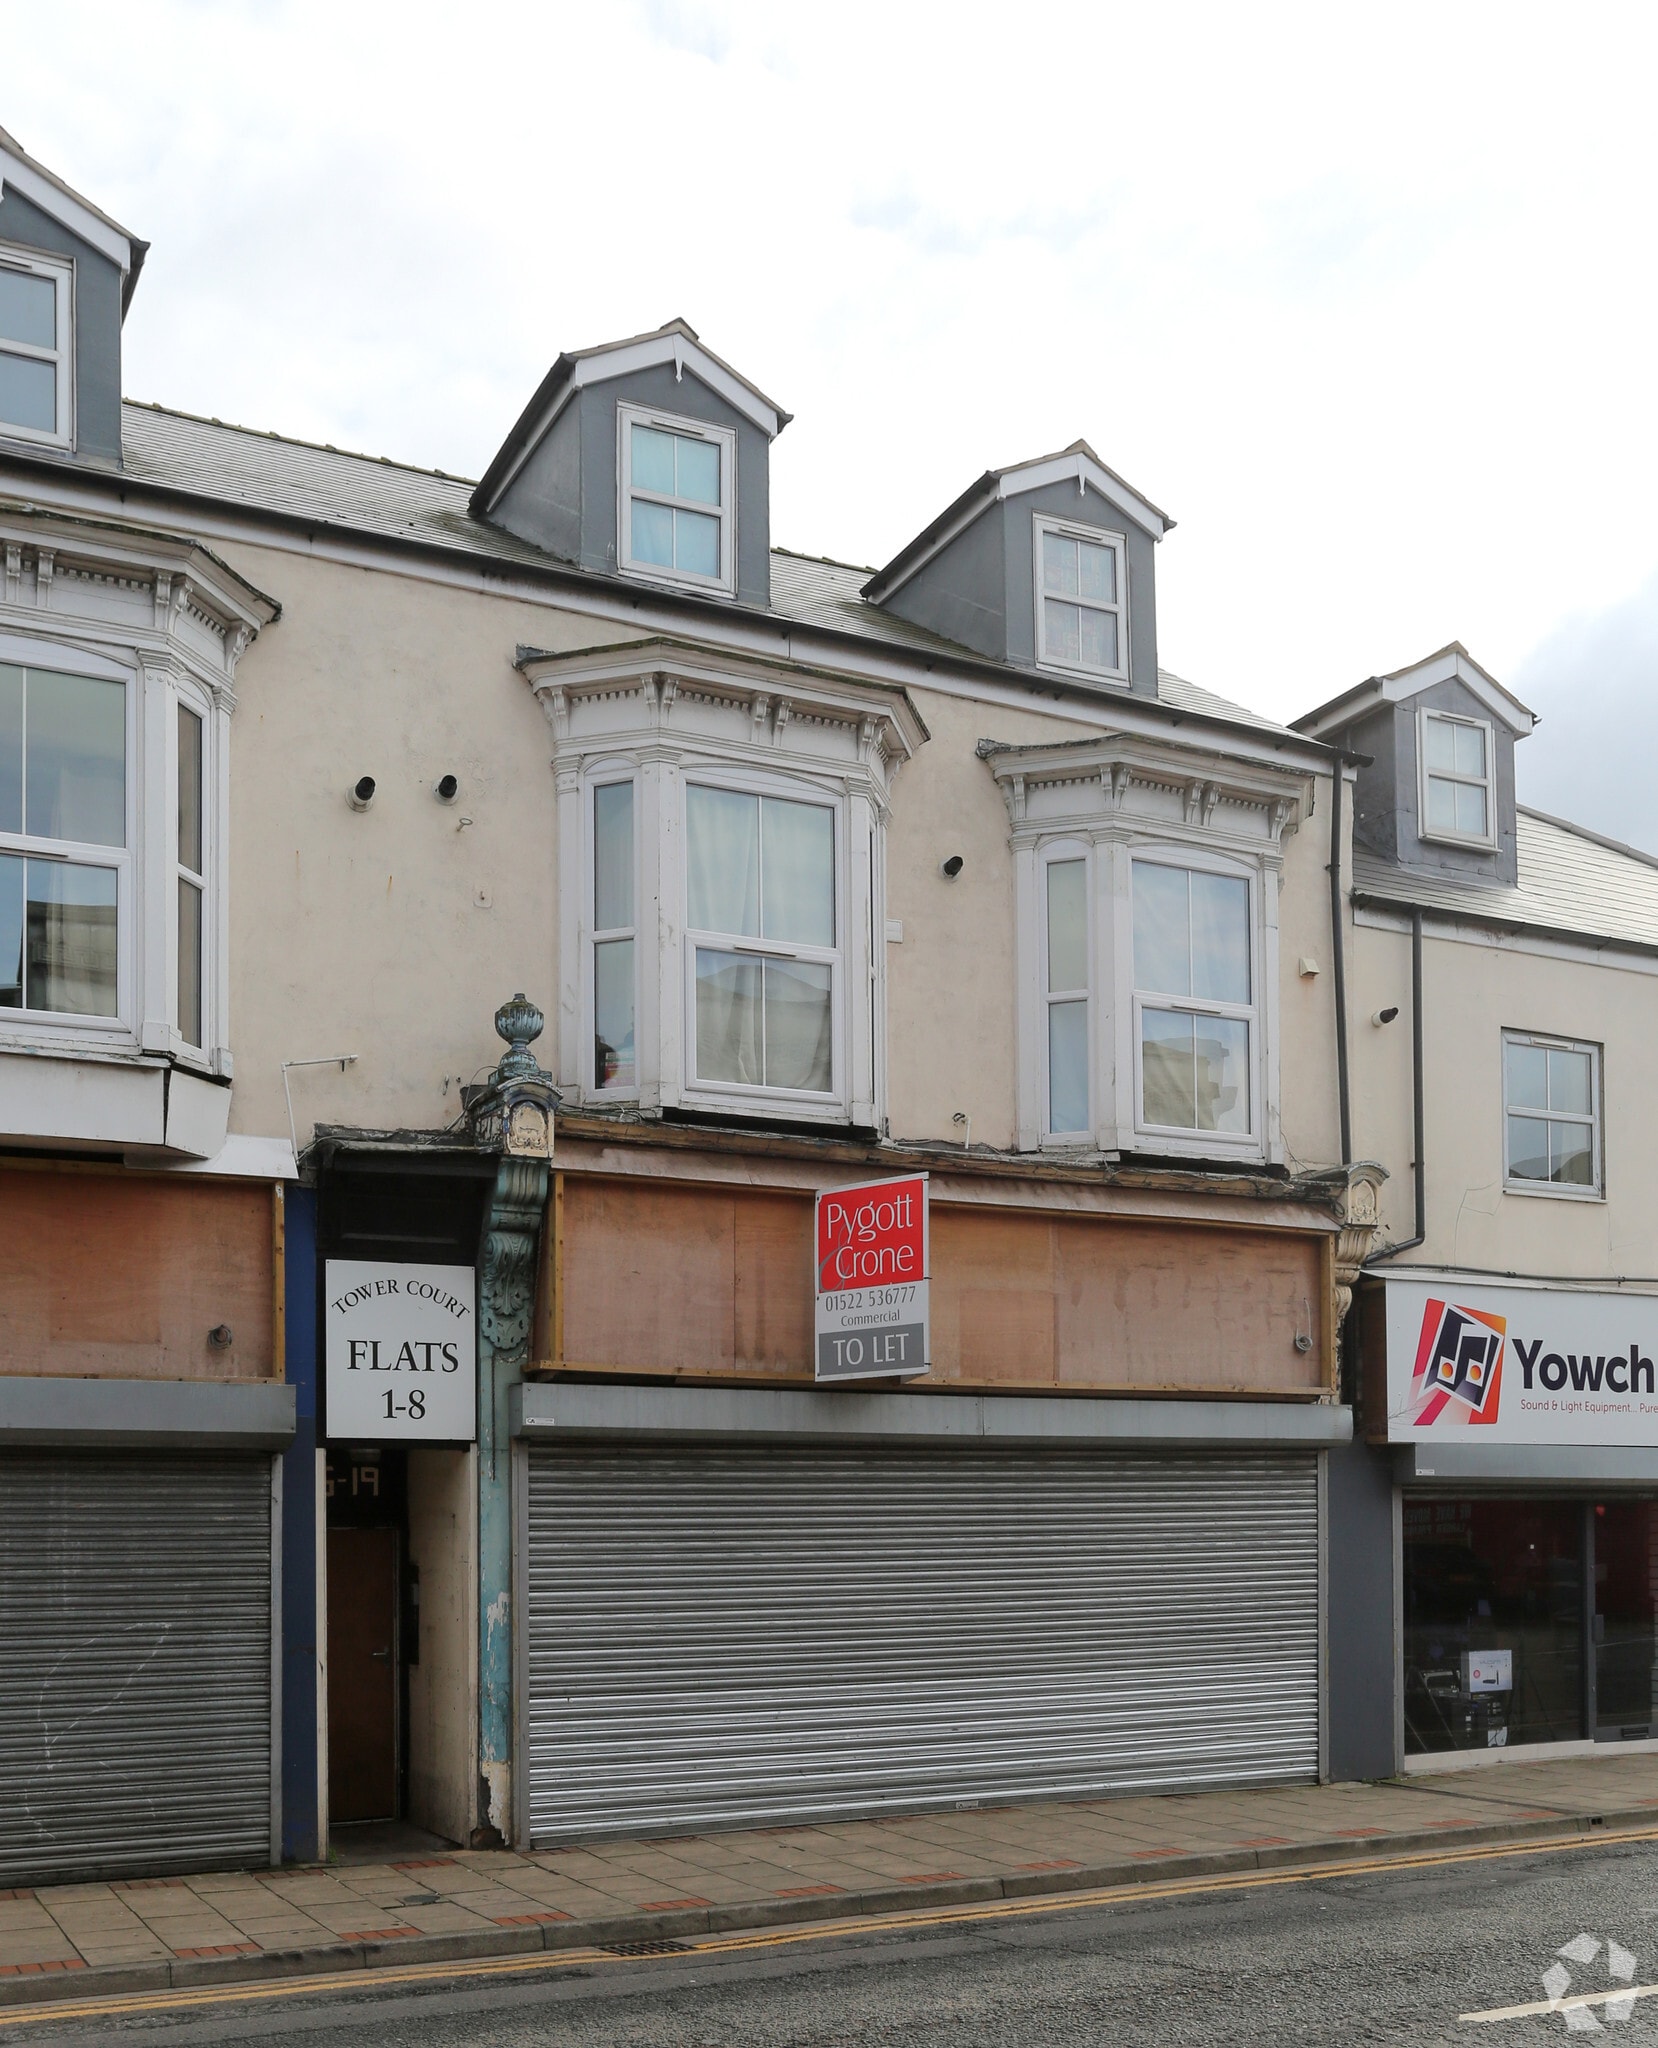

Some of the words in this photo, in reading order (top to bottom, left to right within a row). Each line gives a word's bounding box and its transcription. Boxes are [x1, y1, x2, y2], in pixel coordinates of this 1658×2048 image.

[827, 1193, 914, 1244] Pygott
[835, 1245, 914, 1279] Crone
[331, 1279, 400, 1315] TOWER
[406, 1280, 470, 1320] COURT
[825, 1291, 863, 1312] 01522
[868, 1285, 916, 1308] 536777
[840, 1309, 900, 1327] Commercial
[347, 1339, 459, 1373] FLATS
[832, 1338, 864, 1366] TO
[872, 1333, 909, 1364] LET
[1511, 1338, 1655, 1394] Yowch
[381, 1388, 426, 1420] 1-8
[1520, 1398, 1549, 1411] Sound
[1551, 1400, 1558, 1411] &
[1560, 1400, 1582, 1414] Light
